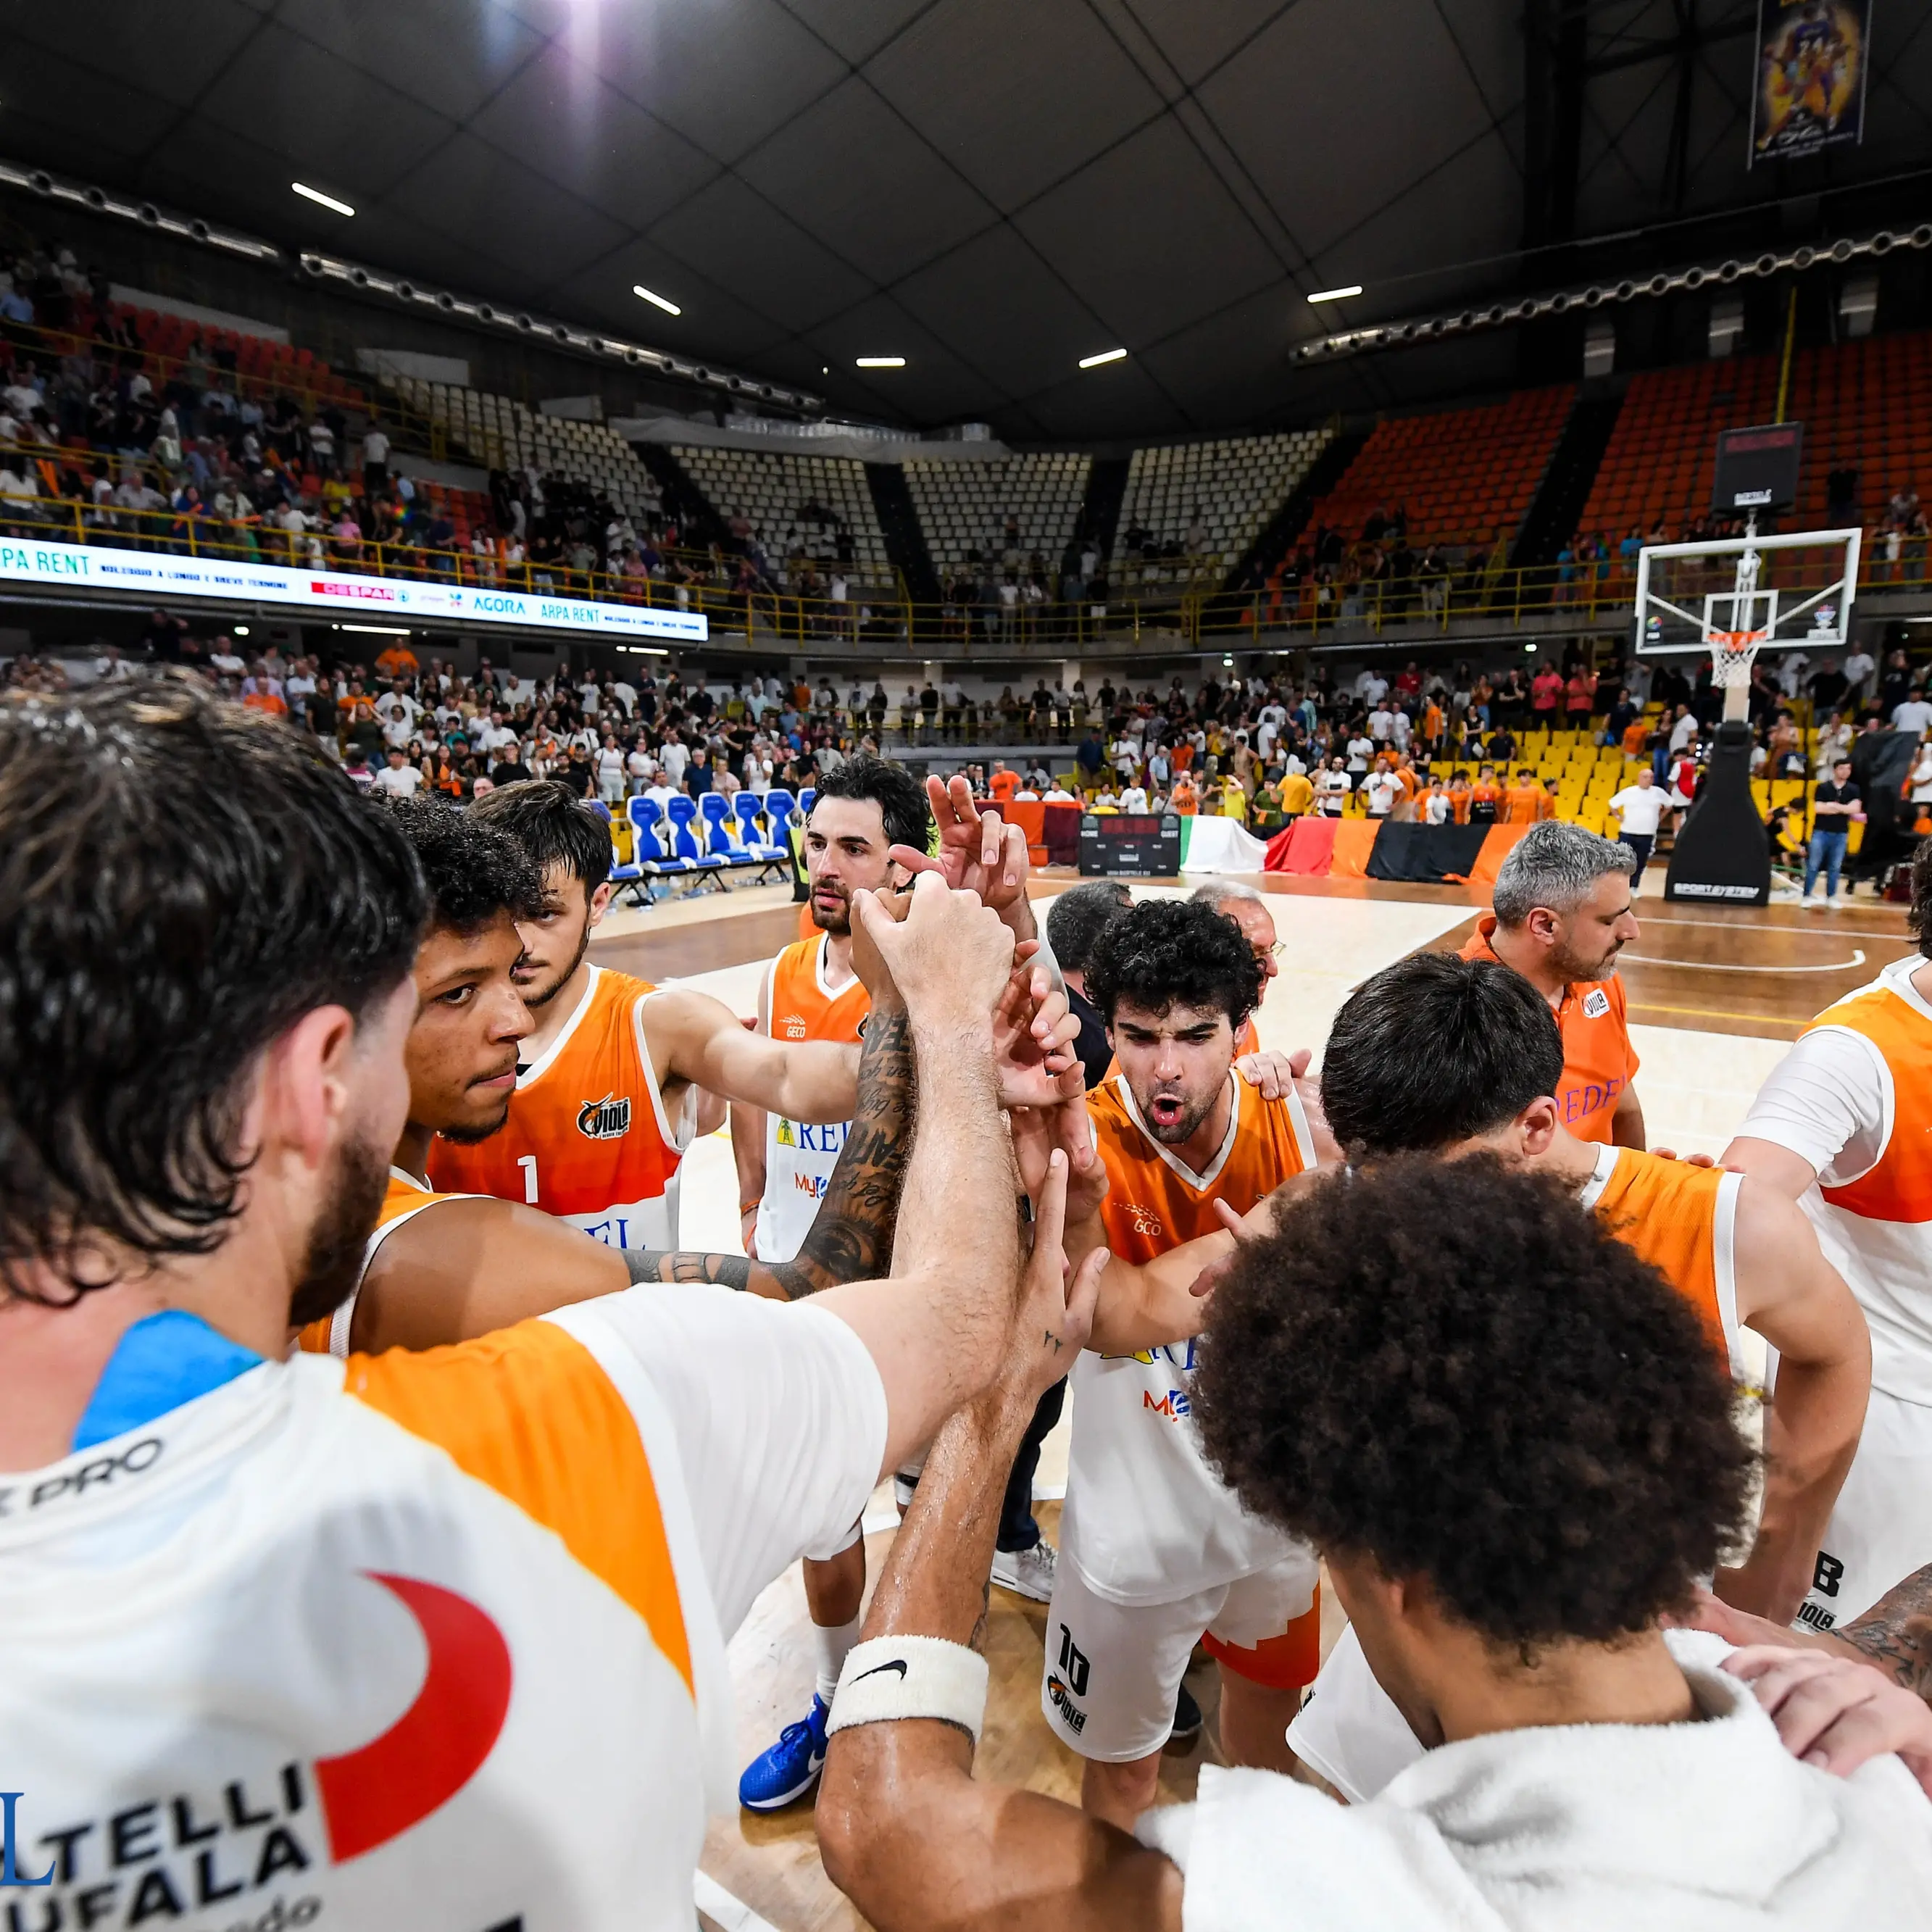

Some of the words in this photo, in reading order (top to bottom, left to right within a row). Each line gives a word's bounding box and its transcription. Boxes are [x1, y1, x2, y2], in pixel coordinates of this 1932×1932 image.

[36, 551, 89, 575] RENT
[541, 604, 570, 620] ARPA
[573, 607, 600, 623] RENT
[786, 1025, 806, 1038] GECO
[594, 1103, 628, 1134] VIOLA
[517, 1154, 538, 1204] 1
[1796, 1602, 1834, 1631] IOLA
[1059, 1622, 1091, 1696] 10
[0, 1761, 308, 1886] TELLI
